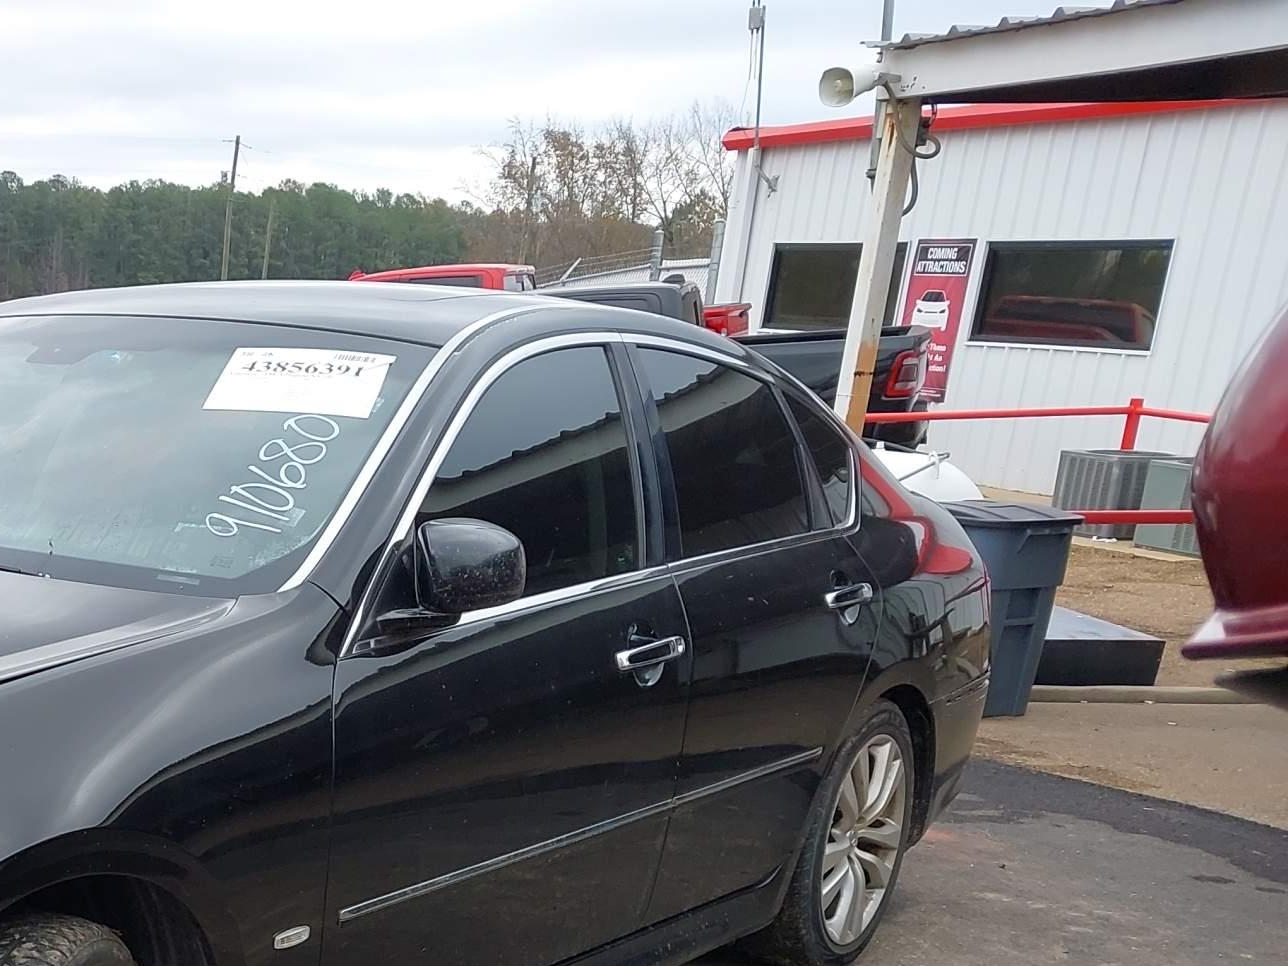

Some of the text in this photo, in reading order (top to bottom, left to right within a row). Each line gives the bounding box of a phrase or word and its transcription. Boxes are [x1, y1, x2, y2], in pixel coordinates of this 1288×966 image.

[927, 247, 958, 259] COMING
[916, 260, 966, 273] ATTRACTIONS
[240, 360, 365, 377] 43856391
[205, 414, 340, 537] 910680
